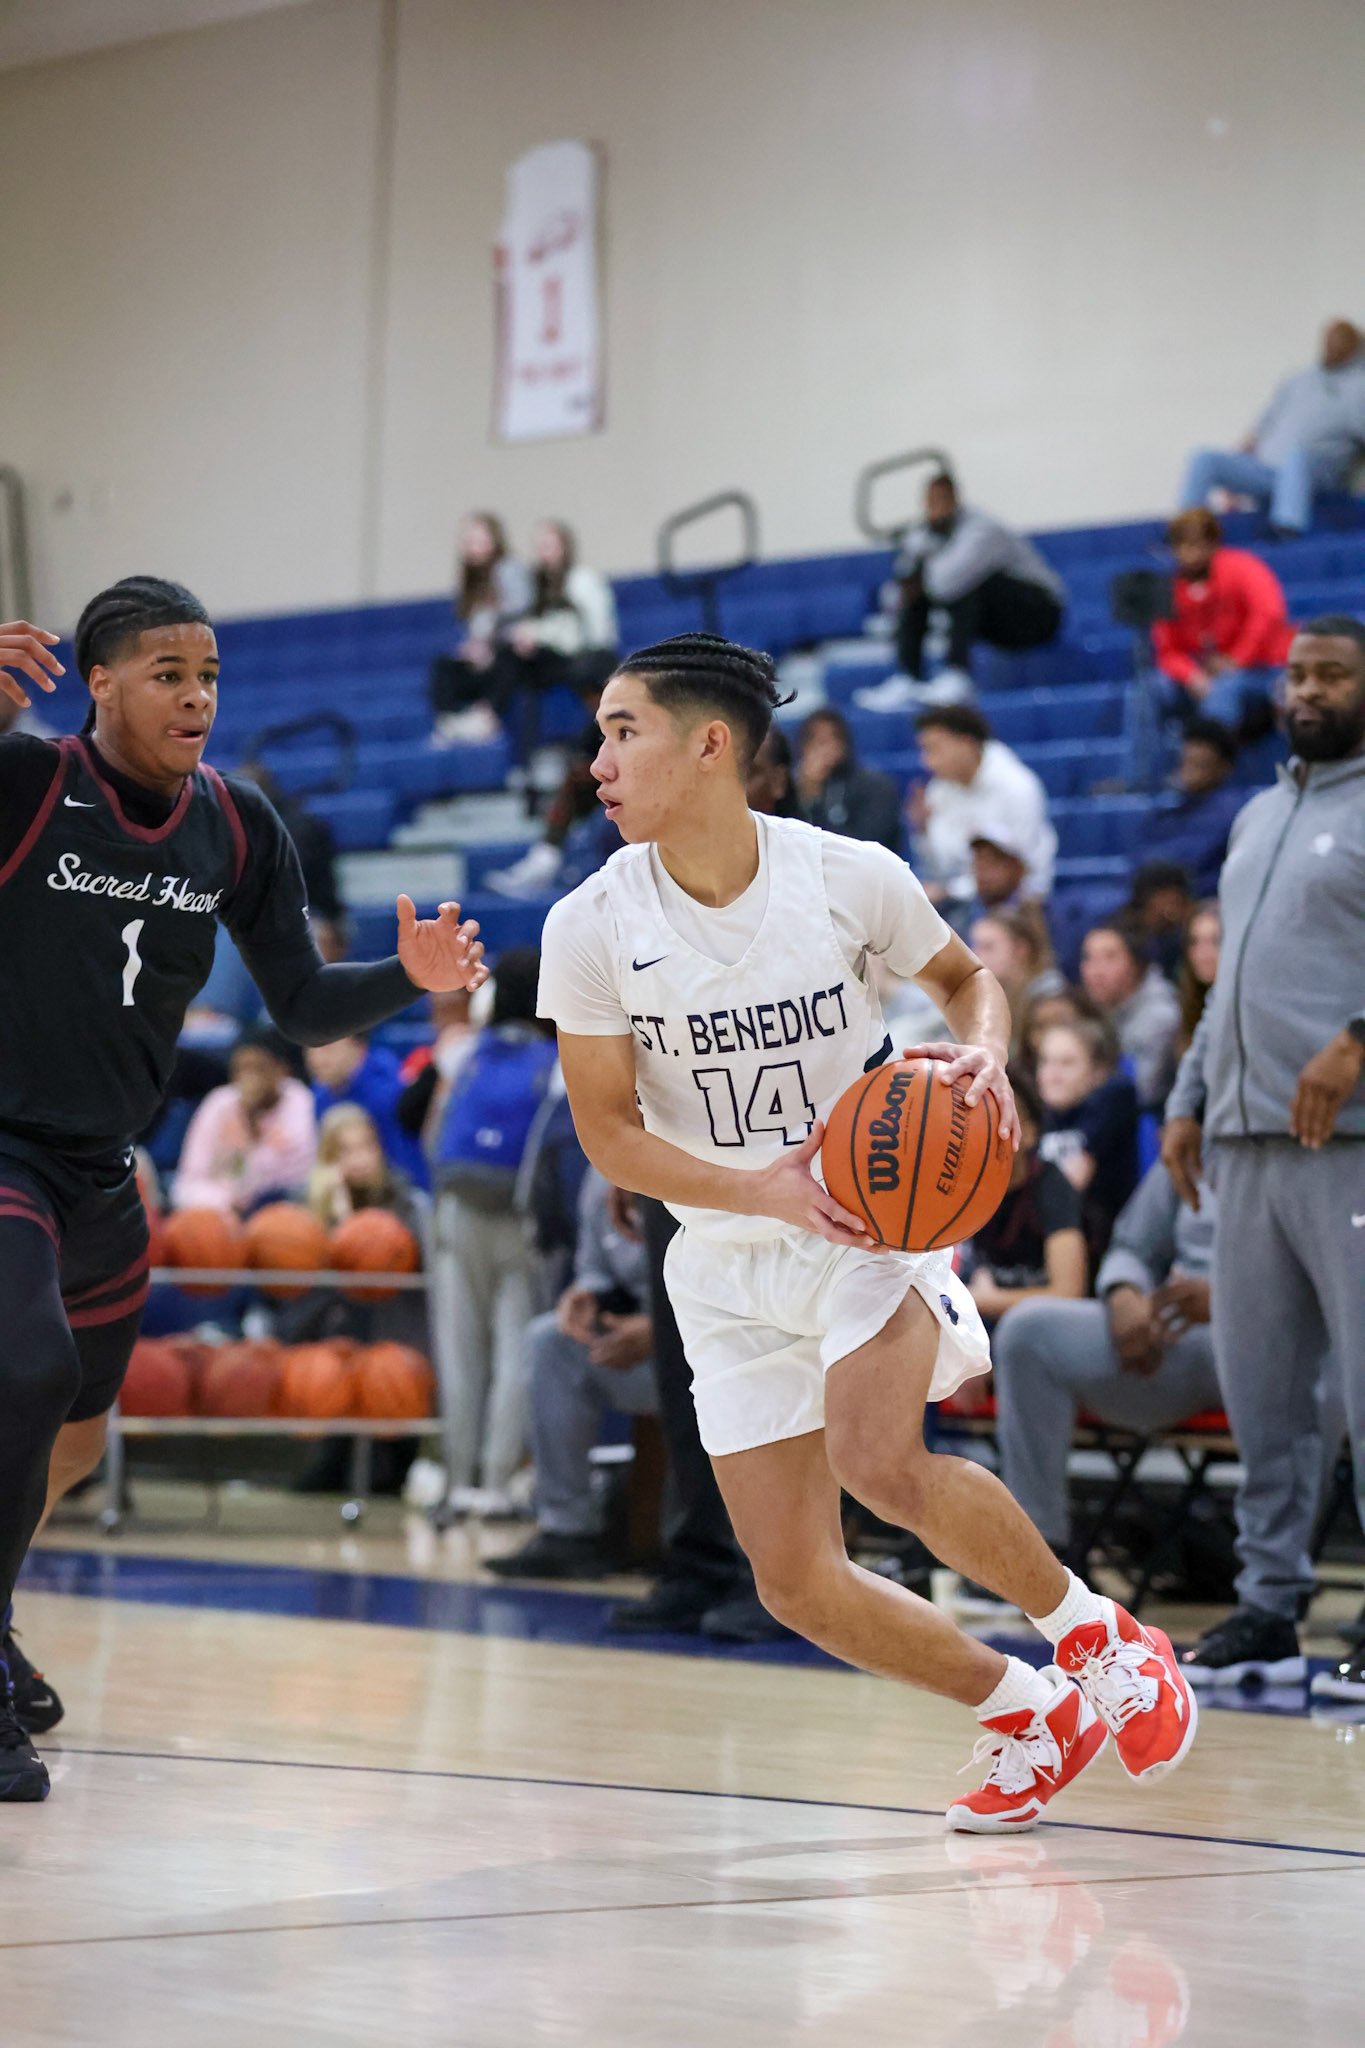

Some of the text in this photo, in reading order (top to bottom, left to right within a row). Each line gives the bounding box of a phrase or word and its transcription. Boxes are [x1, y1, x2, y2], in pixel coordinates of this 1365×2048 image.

[47, 853, 224, 913] Sacred Heart
[121, 919, 145, 1006] 1
[631, 982, 848, 1056] ST. BENEDICT
[692, 1061, 815, 1147] 14
[867, 1070, 919, 1195] Wilson
